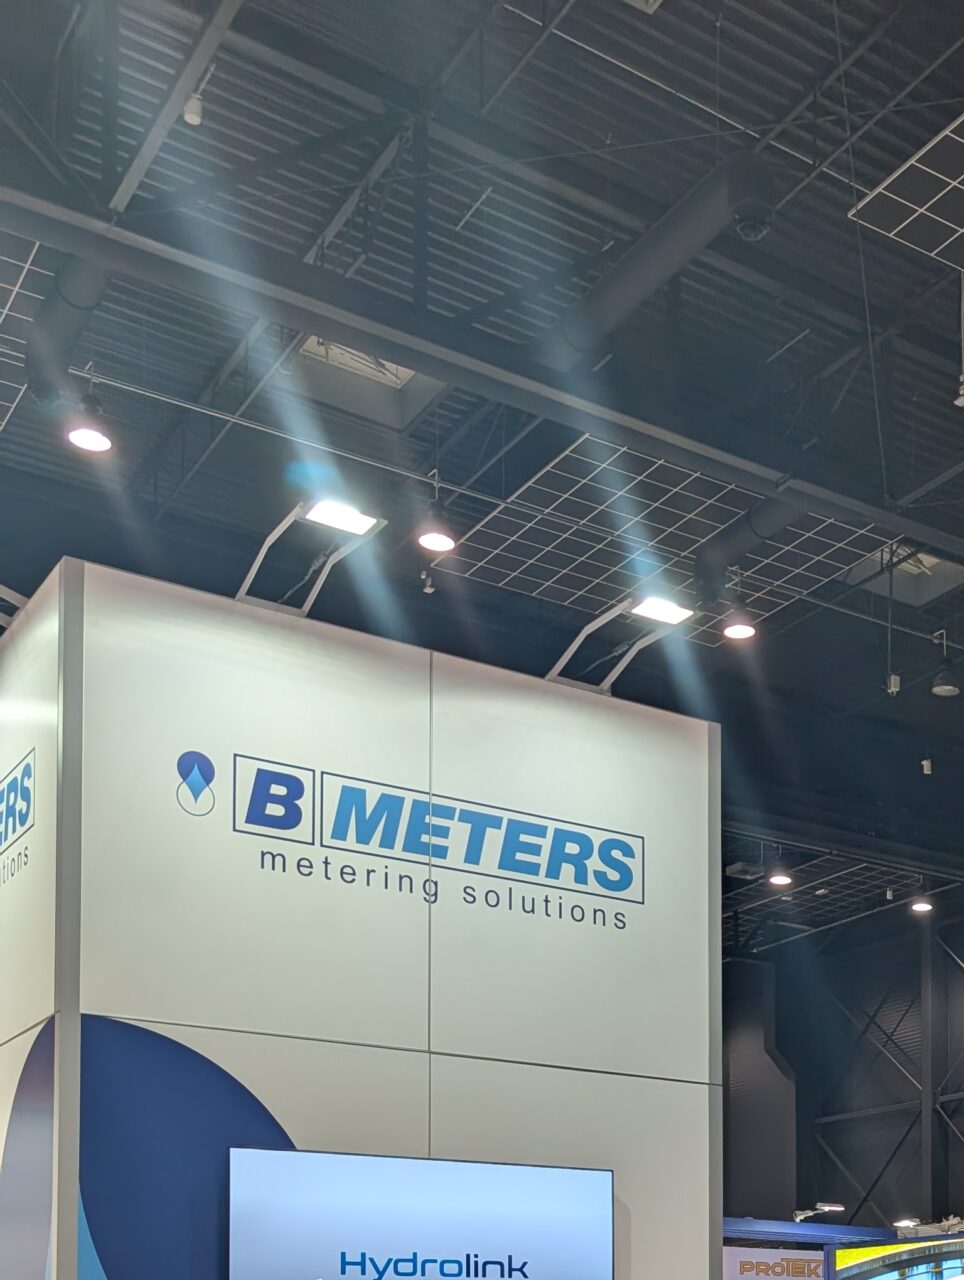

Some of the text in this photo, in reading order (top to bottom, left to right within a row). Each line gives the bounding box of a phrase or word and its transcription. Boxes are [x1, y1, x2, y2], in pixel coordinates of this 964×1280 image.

[244, 767, 636, 893] B METERS
[260, 849, 627, 931] metering solutions
